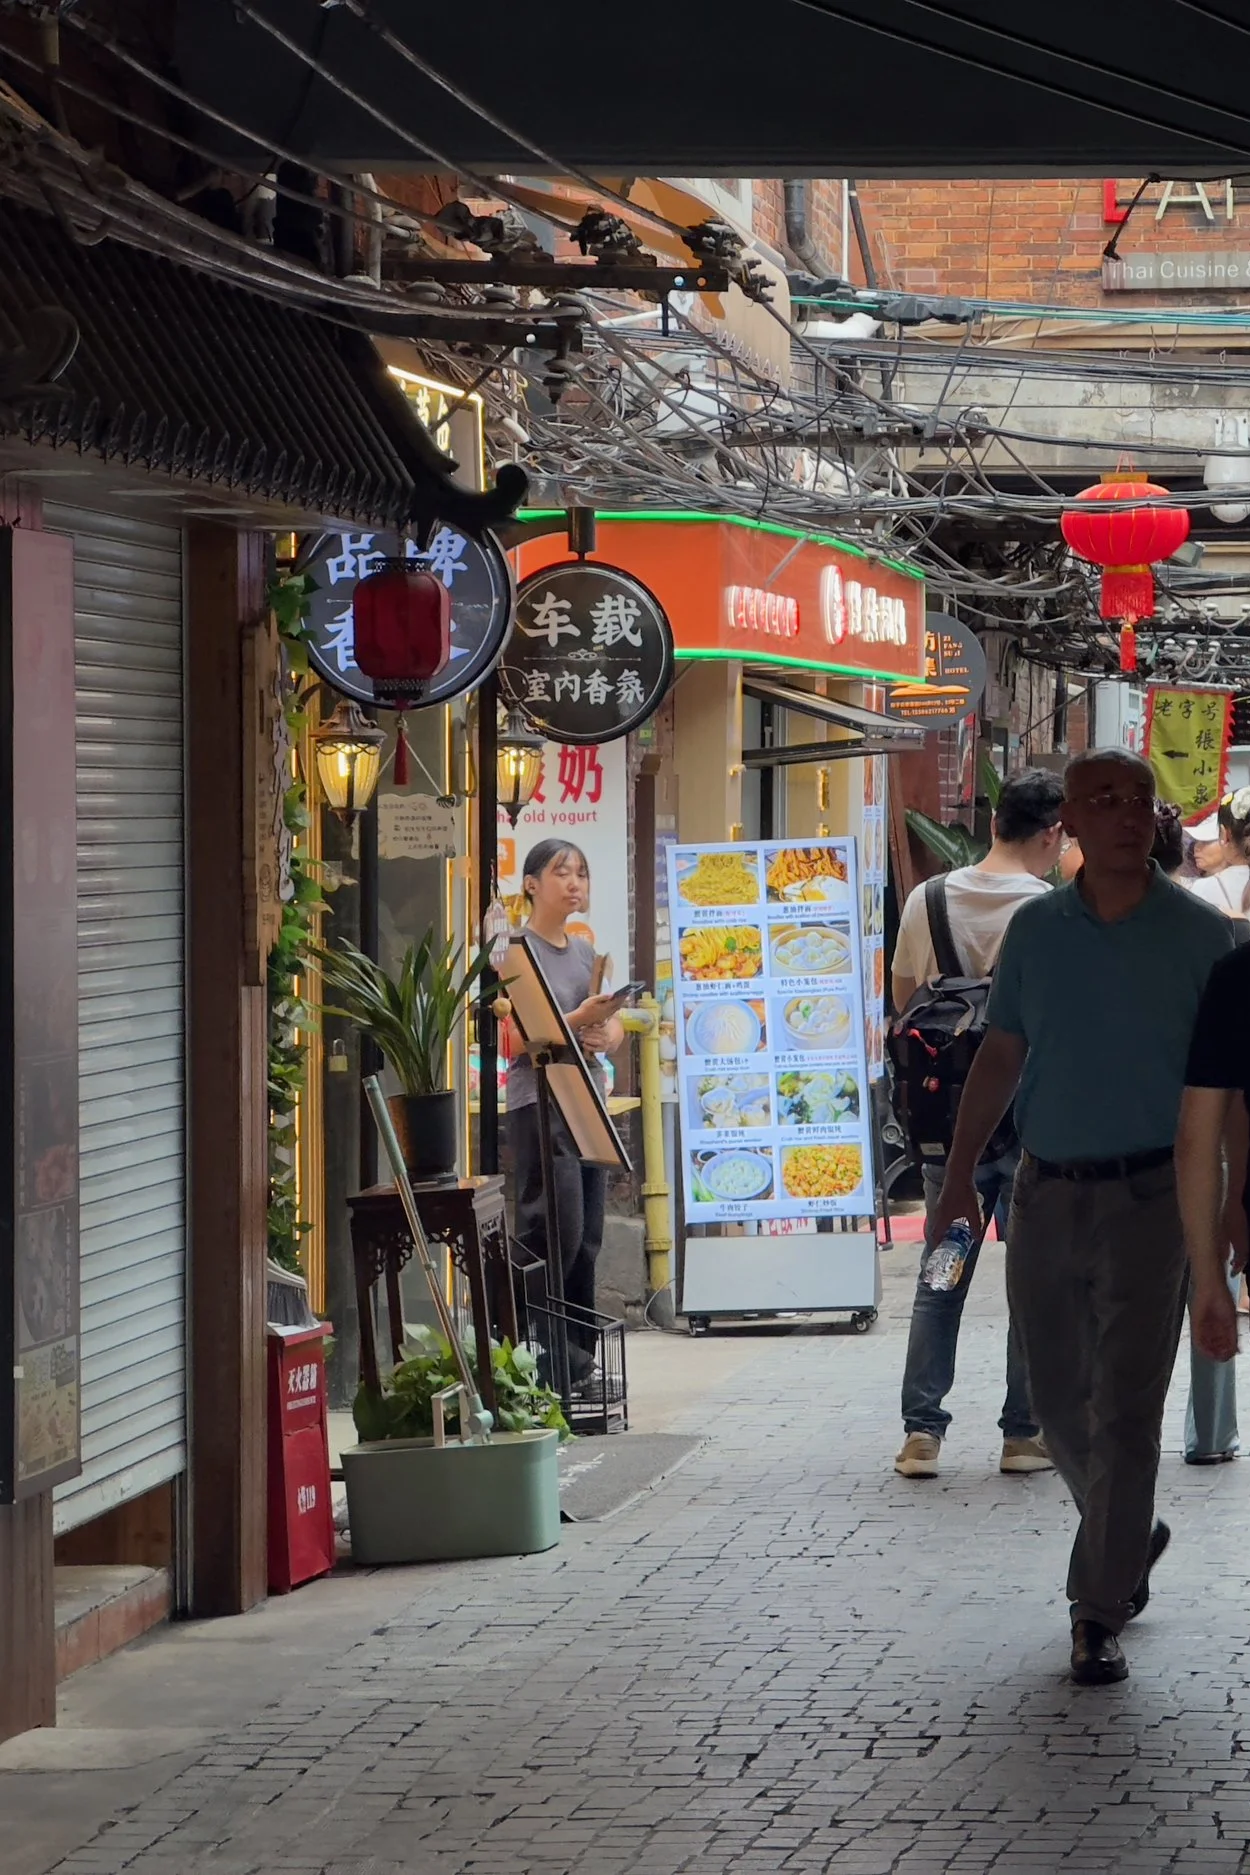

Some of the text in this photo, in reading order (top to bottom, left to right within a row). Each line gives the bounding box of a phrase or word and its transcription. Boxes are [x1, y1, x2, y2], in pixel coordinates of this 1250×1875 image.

[1111, 261, 1154, 280] Thai
[1160, 260, 1240, 279] Cuisine
[523, 591, 644, 648] 车载
[1154, 698, 1220, 721] 老字号
[523, 809, 546, 823] old
[550, 810, 598, 826] yogurt
